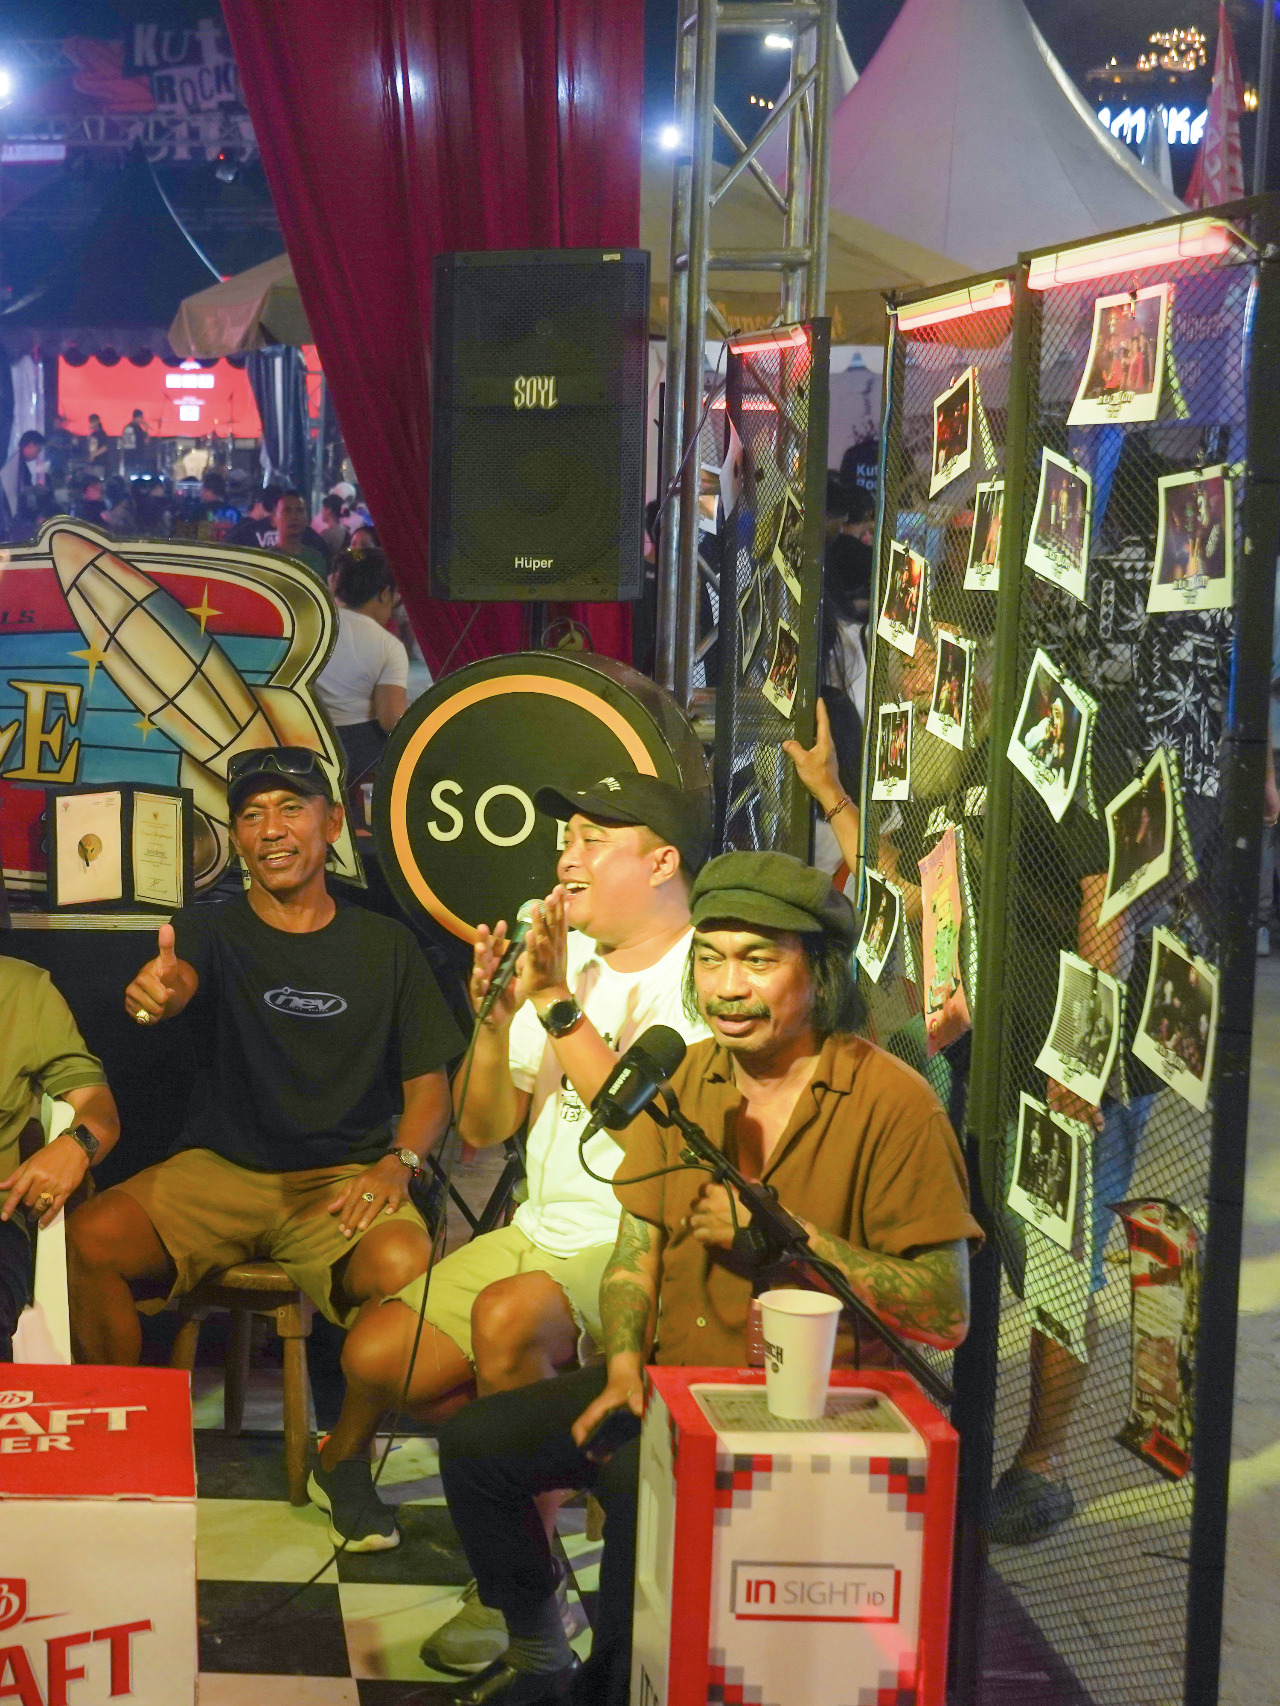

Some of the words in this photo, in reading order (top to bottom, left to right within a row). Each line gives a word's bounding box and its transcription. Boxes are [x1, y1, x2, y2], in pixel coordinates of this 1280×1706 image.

[154, 62, 234, 107] ROCK
[513, 375, 559, 410] SOYL
[514, 556, 554, 571] Hüper
[607, 1067, 632, 1096] SHURE
[783, 1580, 867, 1605] SIGHT
